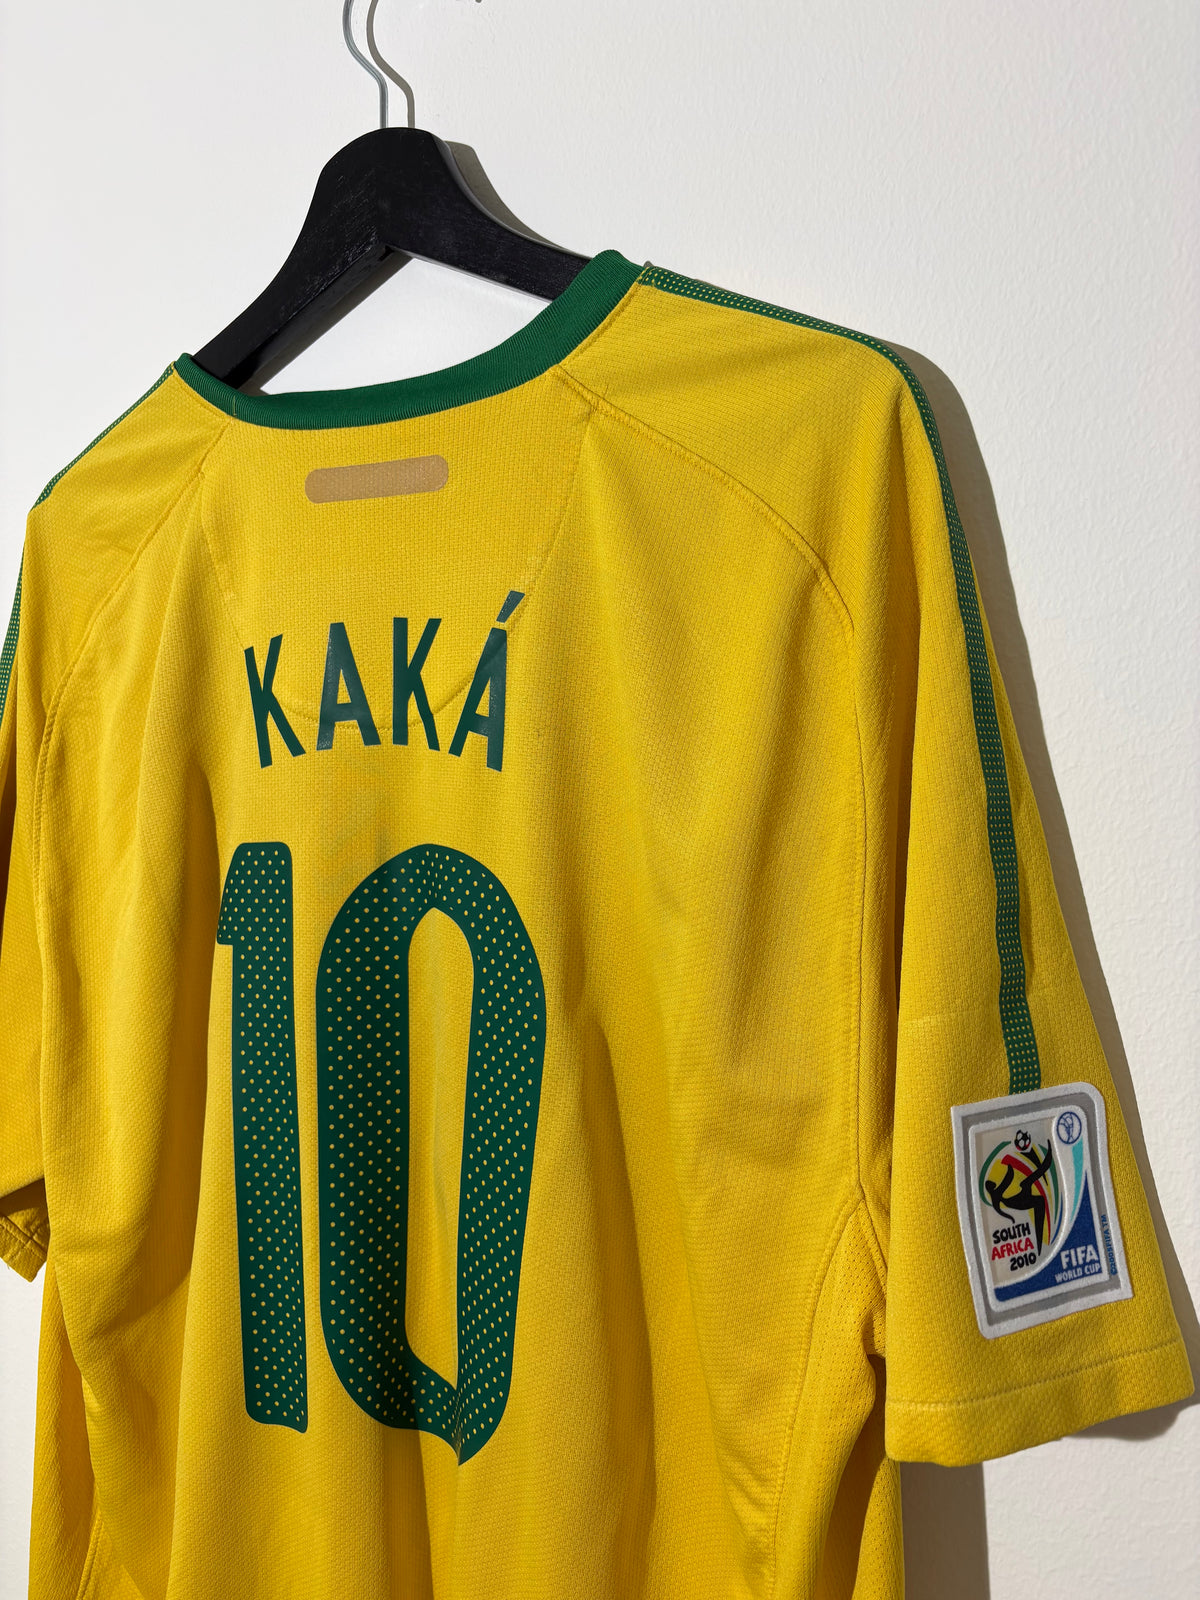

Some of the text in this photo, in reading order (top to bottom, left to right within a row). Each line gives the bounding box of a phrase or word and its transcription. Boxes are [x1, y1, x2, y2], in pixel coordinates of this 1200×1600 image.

[244, 590, 526, 772] KAKÁ
[216, 841, 548, 1465] 10
[992, 1222, 1031, 1245] SOUTH
[991, 1237, 1035, 1261] AFRICA
[1060, 1244, 1099, 1270] FIFA
[1010, 1252, 1036, 1272] 2010
[1055, 1262, 1101, 1284] WORLD CUP
